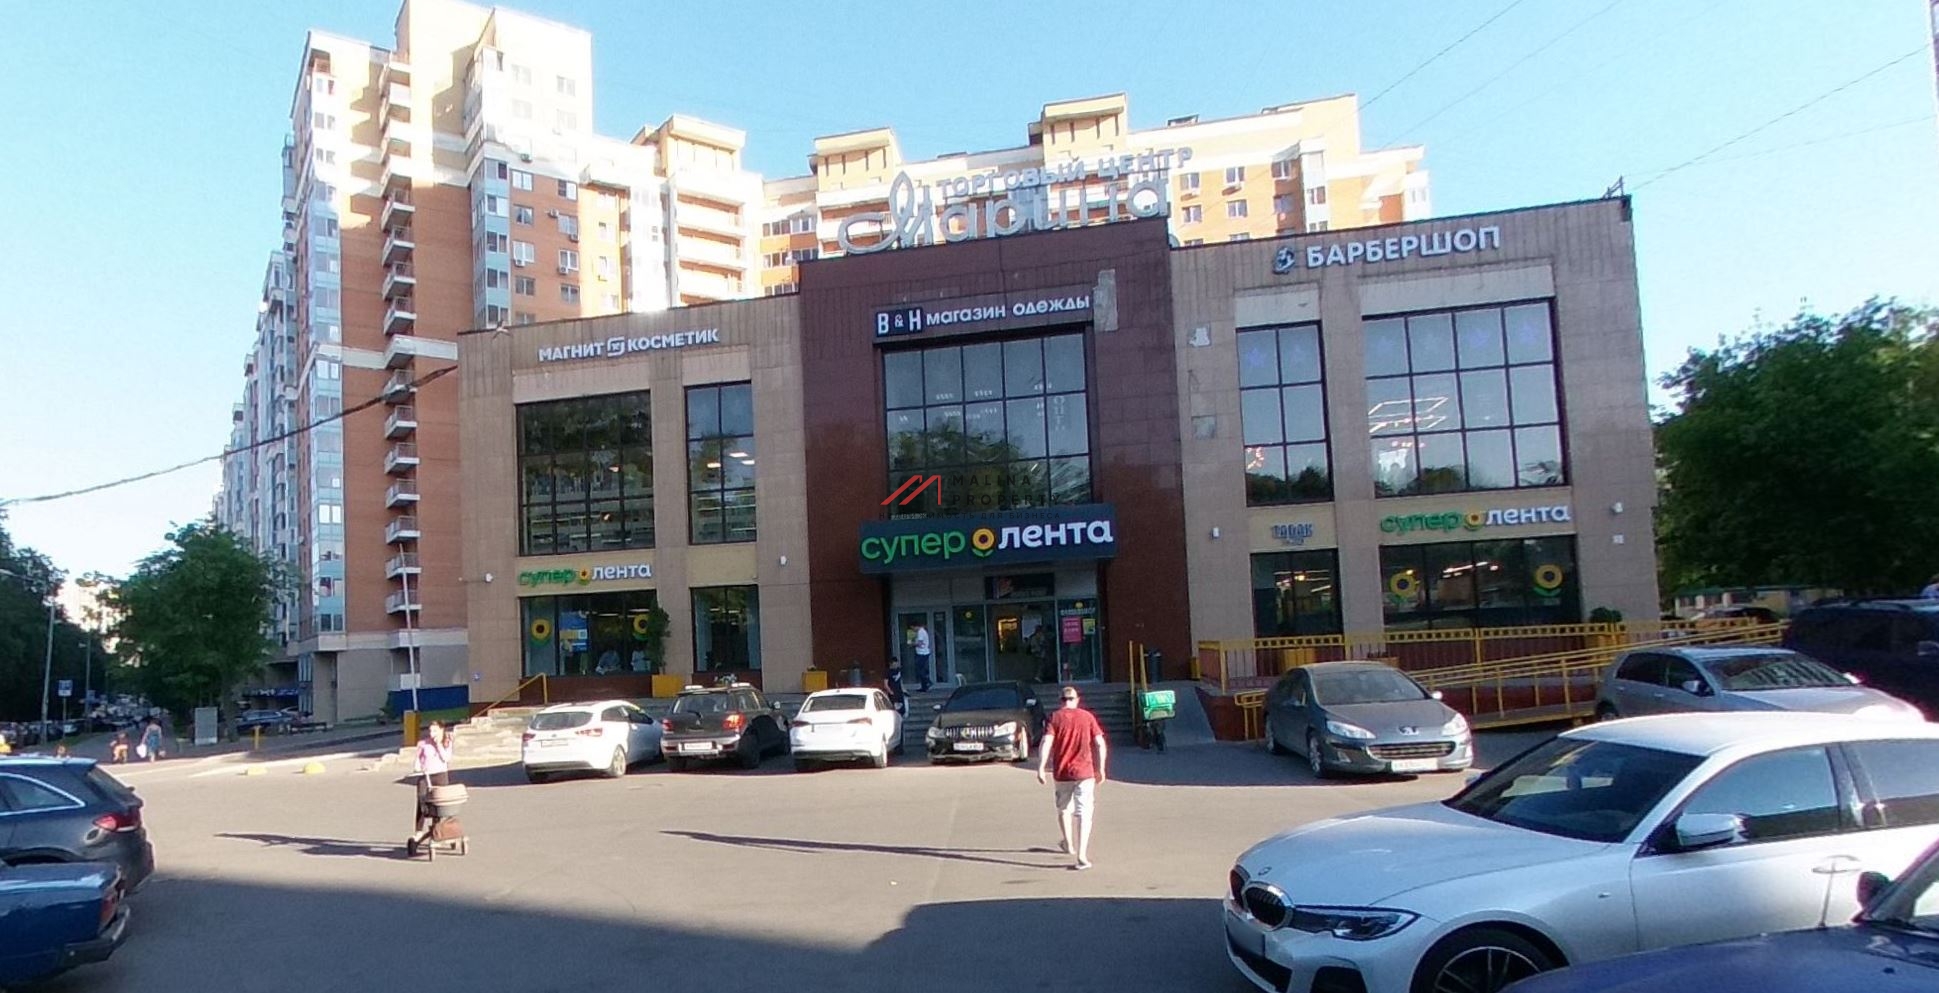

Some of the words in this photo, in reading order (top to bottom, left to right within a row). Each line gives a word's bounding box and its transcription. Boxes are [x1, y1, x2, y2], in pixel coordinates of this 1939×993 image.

[940, 157, 1086, 199] ТОРГОВЫЙ
[1097, 147, 1194, 180] ЦЕНТР
[1306, 225, 1500, 268] БАРБЕРШОП
[877, 312, 889, 334] B
[926, 304, 1007, 326] магазин
[1012, 296, 1090, 317] одежды
[538, 342, 605, 362] МАГНИТ
[627, 328, 720, 352] КОСМЕТИК
[1380, 511, 1461, 536] супер
[1486, 504, 1571, 526] лента
[861, 529, 966, 565] супер
[998, 519, 1113, 550] лента
[518, 567, 577, 588] супер
[592, 563, 651, 581] лента
